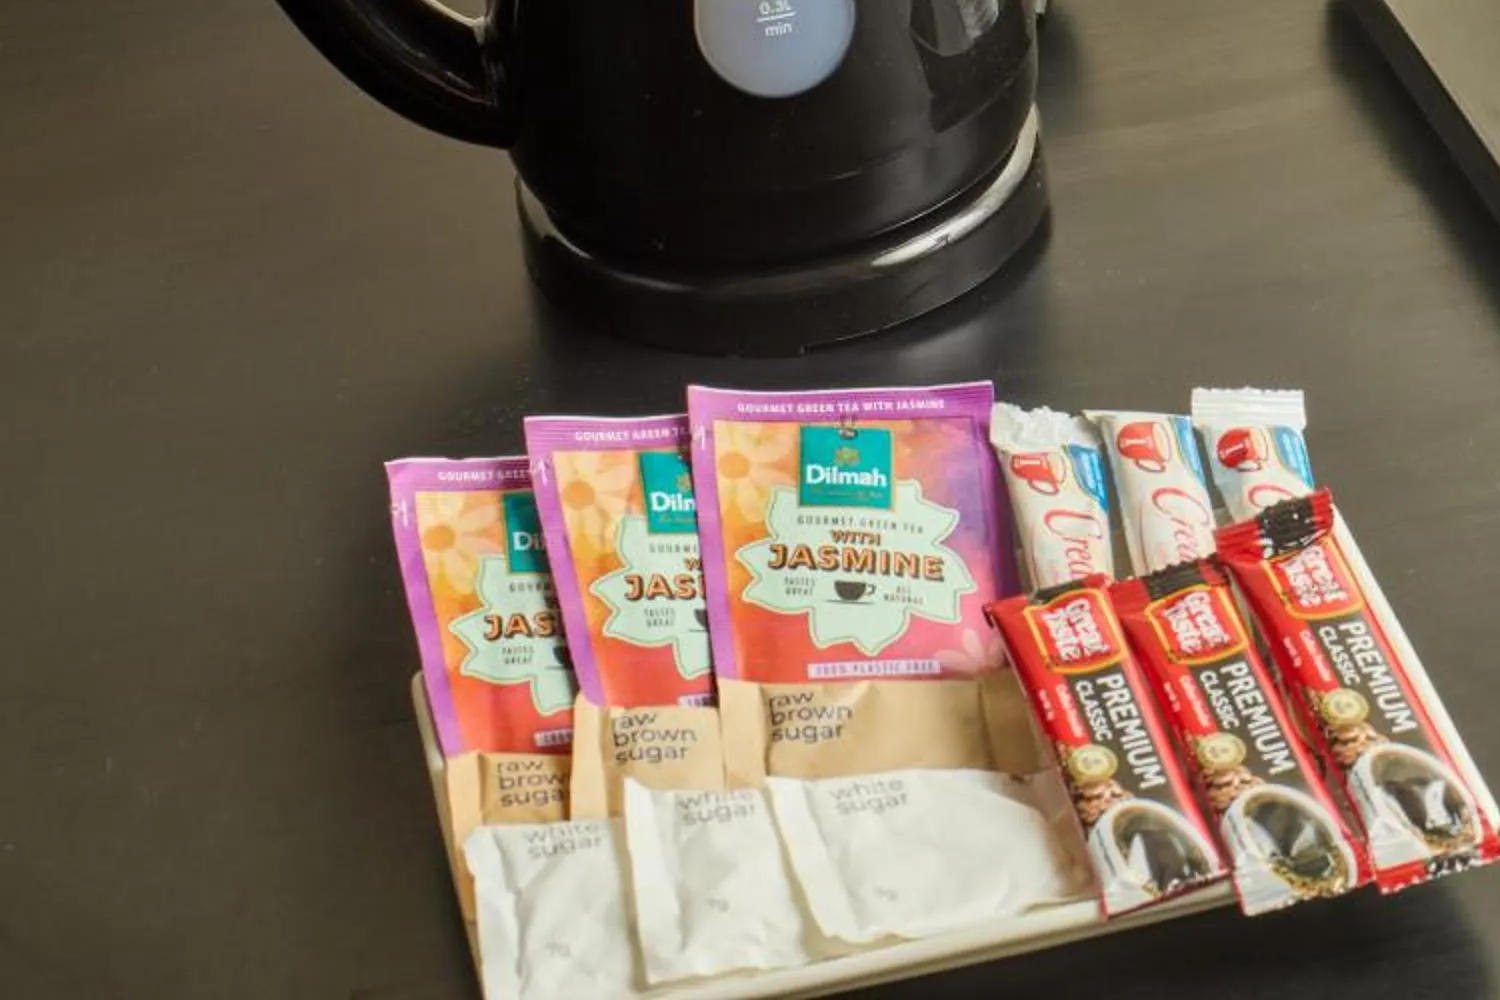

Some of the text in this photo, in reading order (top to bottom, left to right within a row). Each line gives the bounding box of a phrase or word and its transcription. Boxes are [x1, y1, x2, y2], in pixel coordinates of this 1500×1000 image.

[765, 22, 793, 38] min
[737, 399, 945, 414] GOURMET GREEN TEA WITH JASMINE
[437, 470, 495, 482] GOURMET
[805, 463, 888, 488] Dilmah
[650, 490, 698, 512] Dilm
[831, 528, 882, 546] WITH
[767, 543, 946, 583] JASMINE
[1318, 624, 1361, 686] CLASSIC
[1338, 619, 1419, 733] PREMIUM
[769, 690, 815, 712] raw
[1073, 679, 1114, 742] CLASSIC
[1199, 669, 1240, 730] CLASSIC
[612, 712, 659, 734] raw
[770, 704, 853, 727] brown
[1219, 660, 1297, 775] PREMIUM
[613, 727, 698, 748] brown
[772, 723, 844, 744] sugar
[1095, 672, 1167, 790] PREMIUM
[497, 758, 545, 774] raw
[615, 746, 689, 766] sugar
[499, 771, 571, 790] brow
[829, 778, 905, 801] white
[500, 788, 567, 808] suga
[677, 790, 753, 810] white
[835, 793, 909, 816] sugar
[680, 803, 756, 827] sugar
[524, 821, 601, 844] white
[527, 836, 603, 859] sugar
